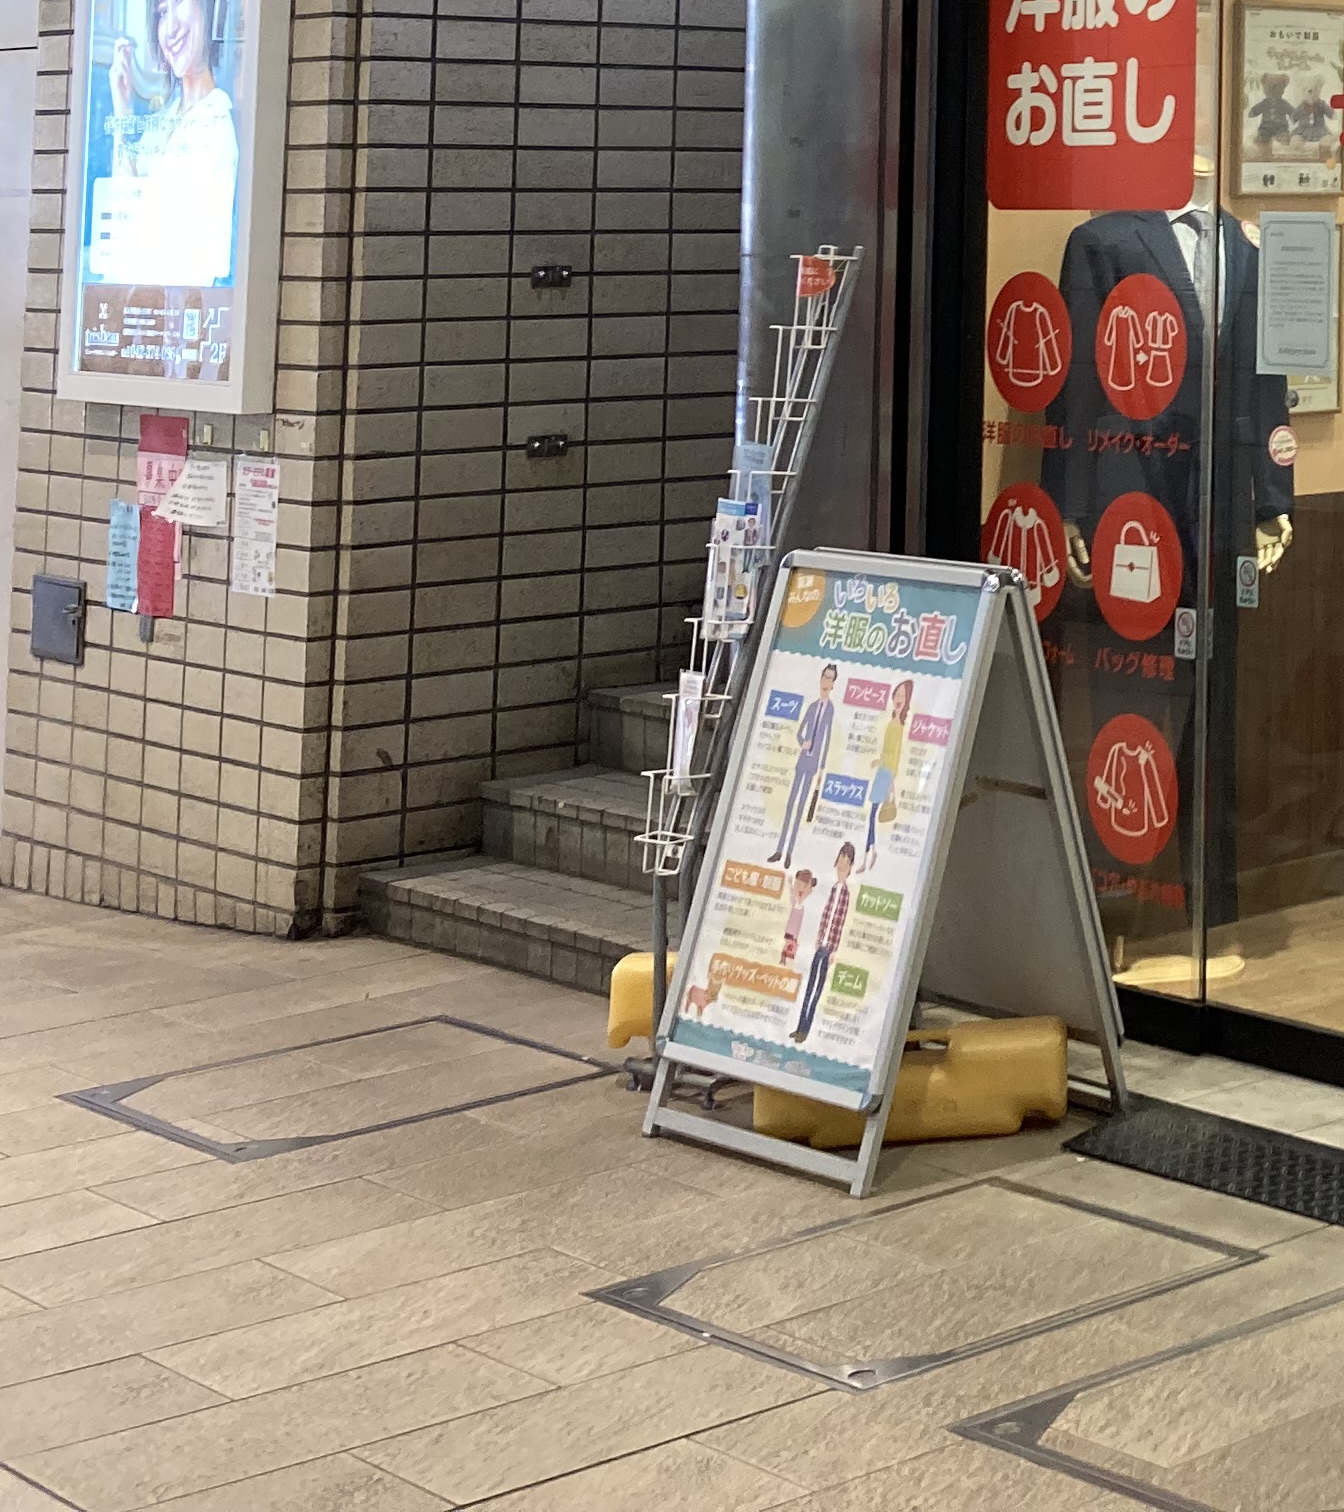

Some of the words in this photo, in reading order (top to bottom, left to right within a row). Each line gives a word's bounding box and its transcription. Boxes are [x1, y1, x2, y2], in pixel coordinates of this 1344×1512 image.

[1005, 56, 1176, 147] お直し
[1087, 427, 1191, 458] リメイク・オーダー
[833, 573, 900, 614] いろいろ
[820, 607, 967, 665] 洋服のお直し
[770, 696, 799, 714] スーツ
[849, 684, 886, 704] ワンピース
[911, 718, 950, 740] ジャケット
[824, 779, 865, 800] スラックス
[859, 890, 898, 911] カットソー
[837, 969, 864, 991] デニム
